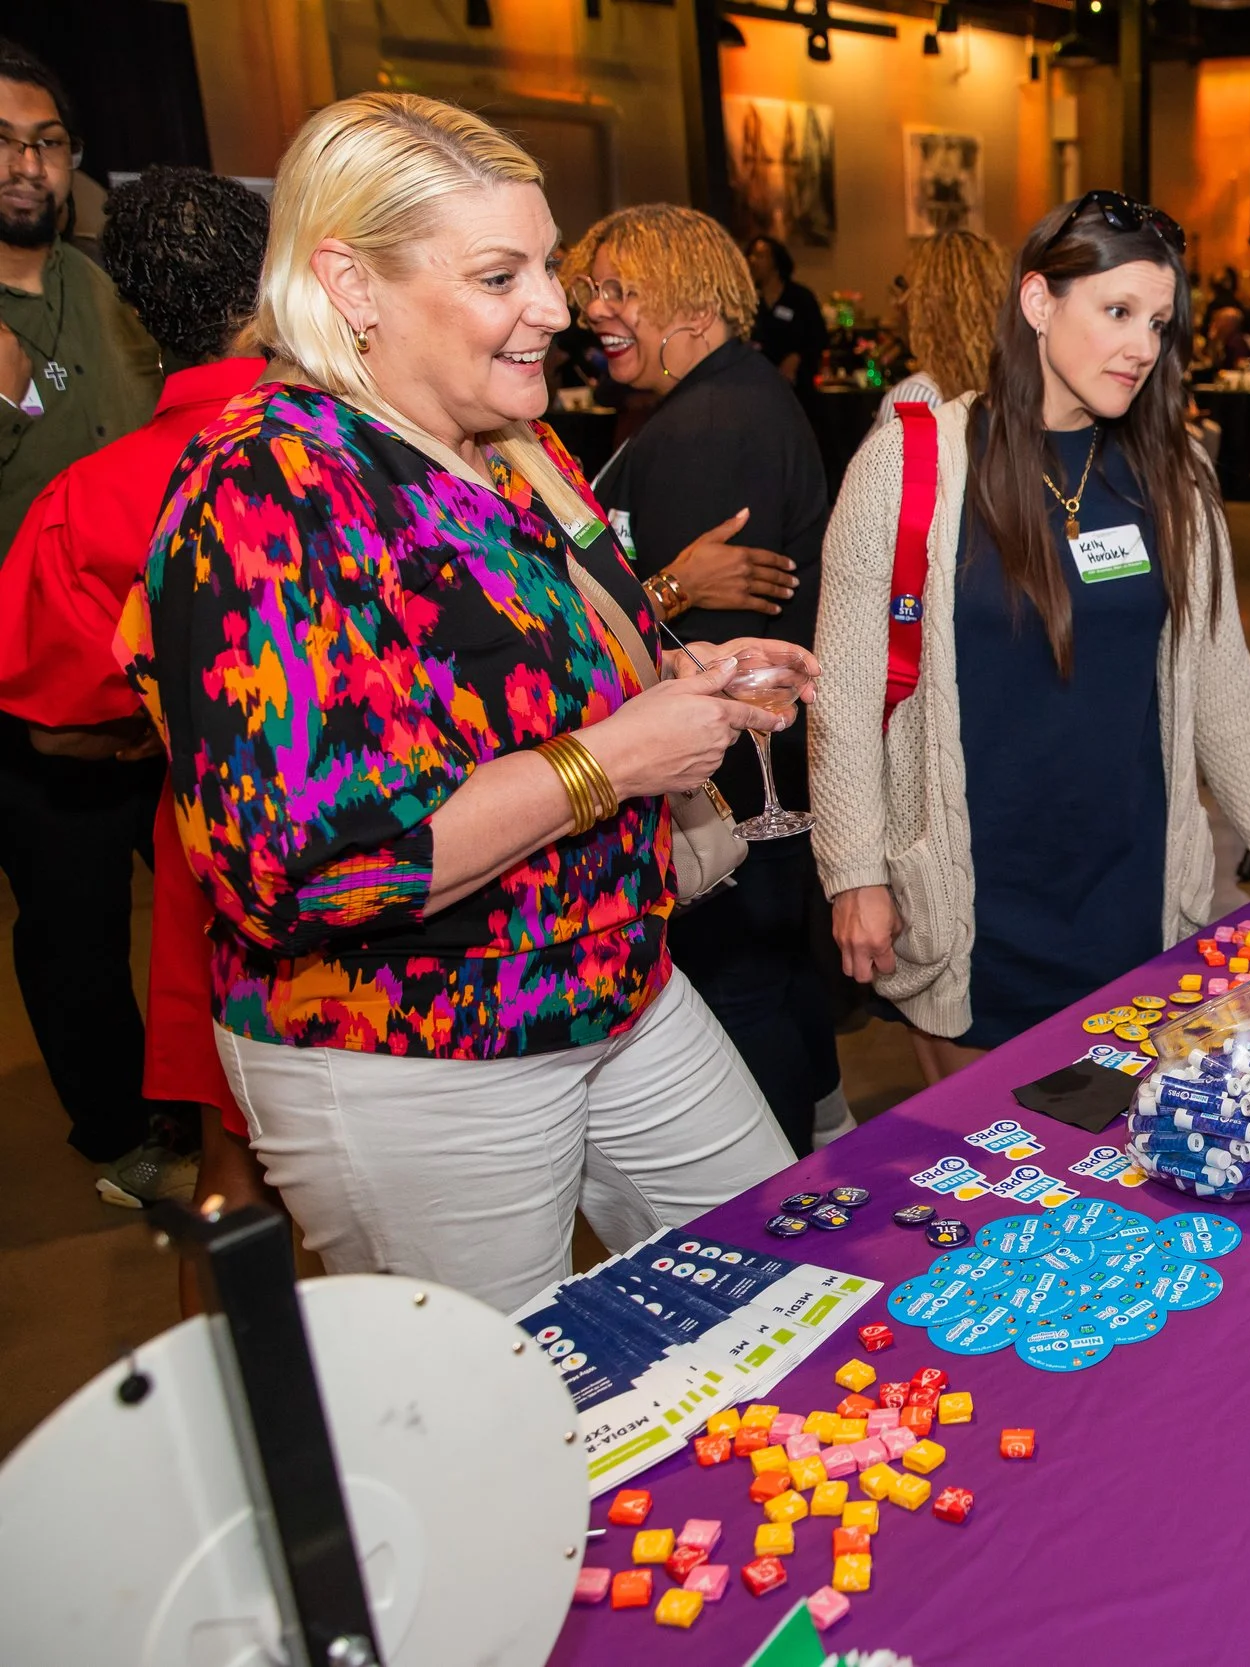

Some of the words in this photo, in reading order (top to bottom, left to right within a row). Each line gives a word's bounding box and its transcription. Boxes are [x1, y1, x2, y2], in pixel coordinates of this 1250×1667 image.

[1079, 539, 1106, 553] Kelly
[899, 607, 914, 616] STL
[1168, 1089, 1180, 1098] PBS
[967, 1130, 998, 1144] PBS
[987, 1131, 1029, 1150] Nine
[1072, 1157, 1101, 1173] PBS
[1097, 1157, 1132, 1177] Nine
[913, 1168, 944, 1184] PBS
[935, 1169, 978, 1190] Nine
[993, 1177, 1022, 1195] PBS
[1017, 1177, 1055, 1200] Nine
[821, 1208, 841, 1219] STL
[936, 1225, 957, 1234] STL
[1121, 1227, 1148, 1236] Nine
[1018, 1242, 1030, 1253] PBS
[1202, 1240, 1213, 1252] PBS
[1066, 1252, 1084, 1264] PBS
[944, 1282, 963, 1297] Nine
[1168, 1290, 1182, 1304] PBS
[921, 1305, 940, 1320] PBS
[1026, 1301, 1041, 1314] PBS
[1127, 1301, 1150, 1317] Nine
[984, 1308, 1005, 1323] Nine
[959, 1333, 978, 1347] PBS
[1073, 1337, 1101, 1346] Nine
[1029, 1344, 1051, 1354] PBS
[580, 1366, 597, 1377] Why
